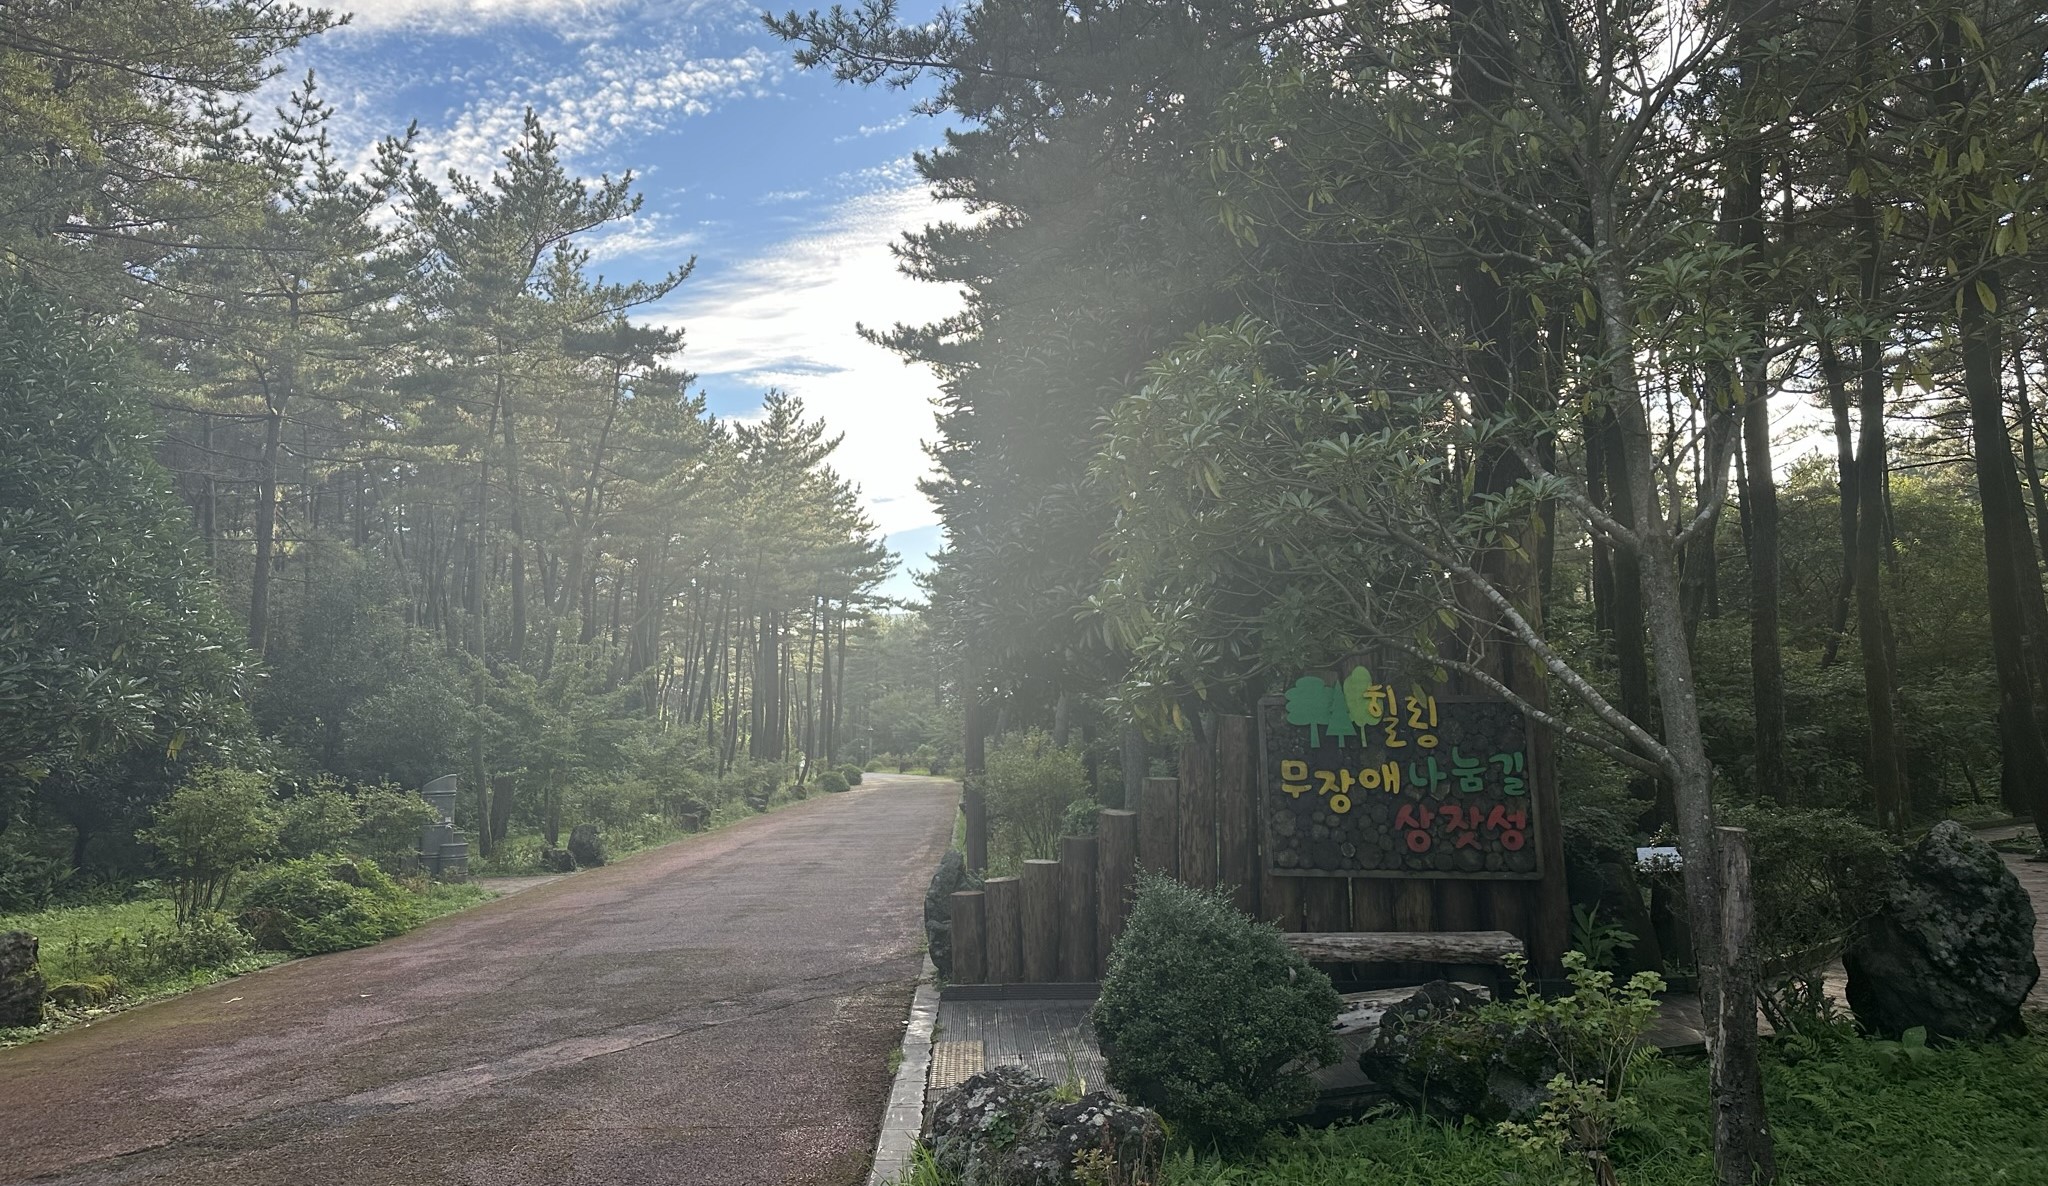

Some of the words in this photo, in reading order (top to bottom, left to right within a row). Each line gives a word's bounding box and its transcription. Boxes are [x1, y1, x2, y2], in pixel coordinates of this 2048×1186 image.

[1363, 684, 1439, 748] 힐링
[1281, 760, 1401, 814] 무장애
[1409, 746, 1526, 796] 나눔길
[1395, 804, 1527, 853] 상잣성
